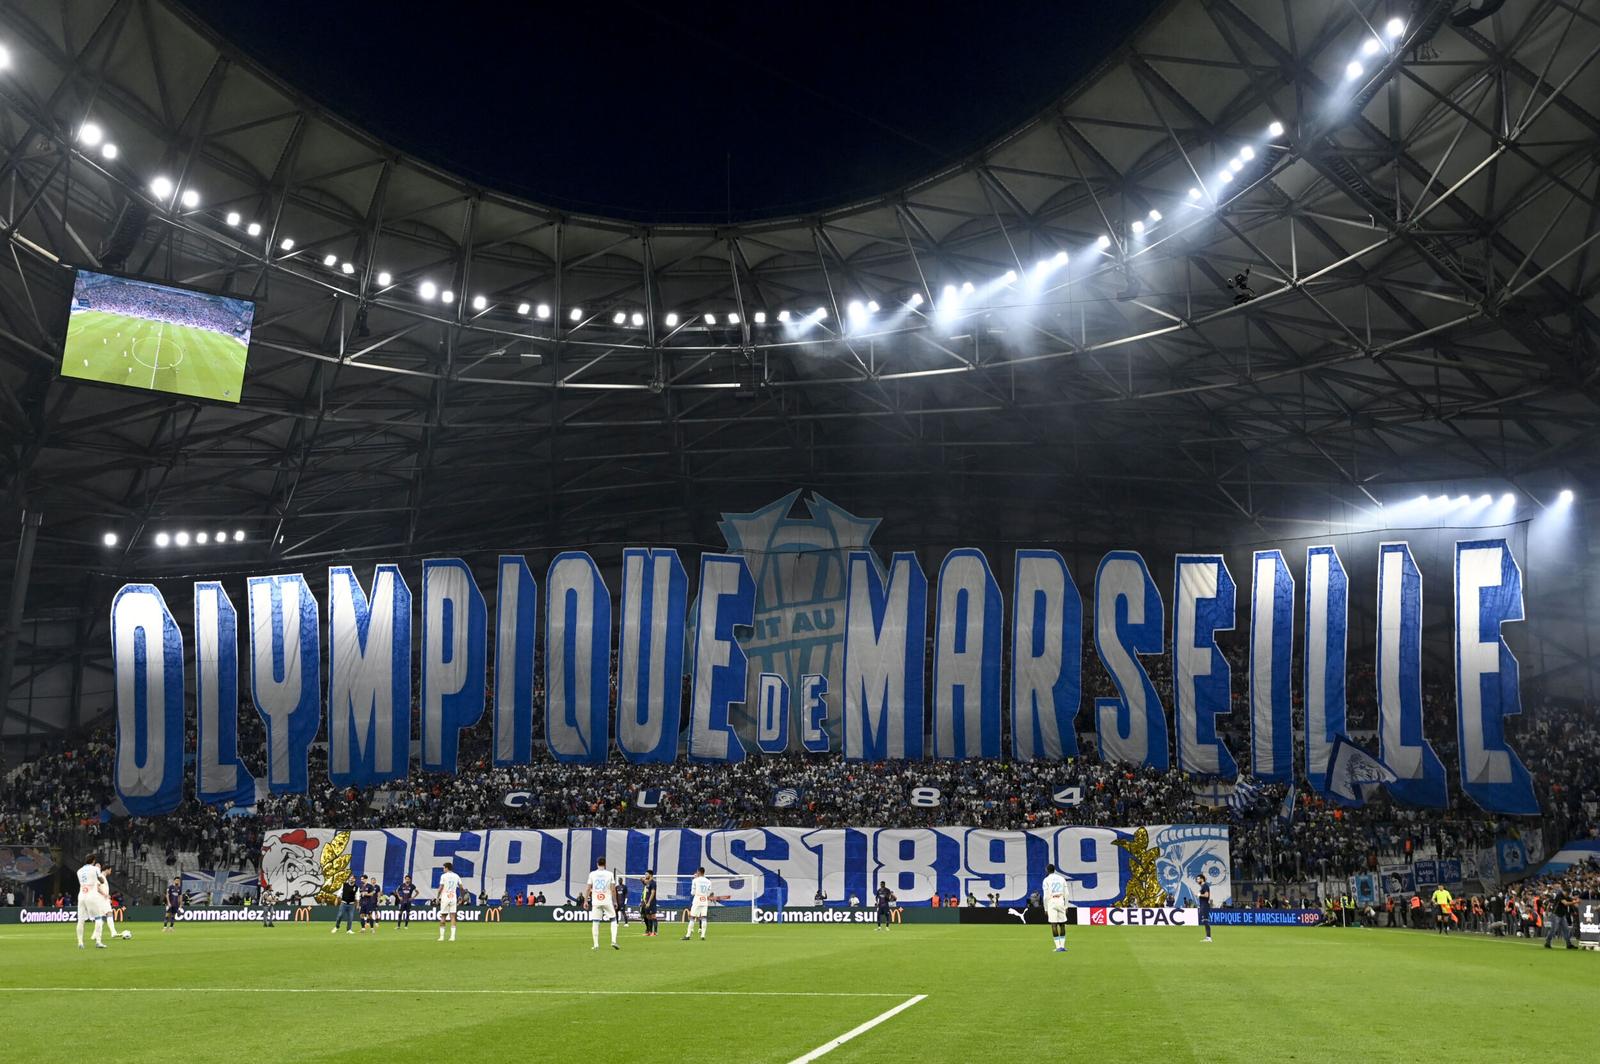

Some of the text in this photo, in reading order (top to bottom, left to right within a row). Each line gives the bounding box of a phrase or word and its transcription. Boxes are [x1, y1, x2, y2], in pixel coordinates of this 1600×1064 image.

[792, 608, 836, 634] AU
[110, 538, 1541, 817] OLYMPIQUE DE MARSEILLE
[343, 827, 1127, 906] DEPUIS 1899
[20, 908, 77, 922] Commandez
[175, 907, 264, 921] Commandez
[456, 910, 481, 921] sur
[753, 908, 851, 922] Commandez
[1109, 908, 1185, 925] CEPAC
[1208, 911, 1242, 924] YMPIQUE
[1243, 911, 1253, 923] DE
[1255, 911, 1297, 924] MARSEILLE
